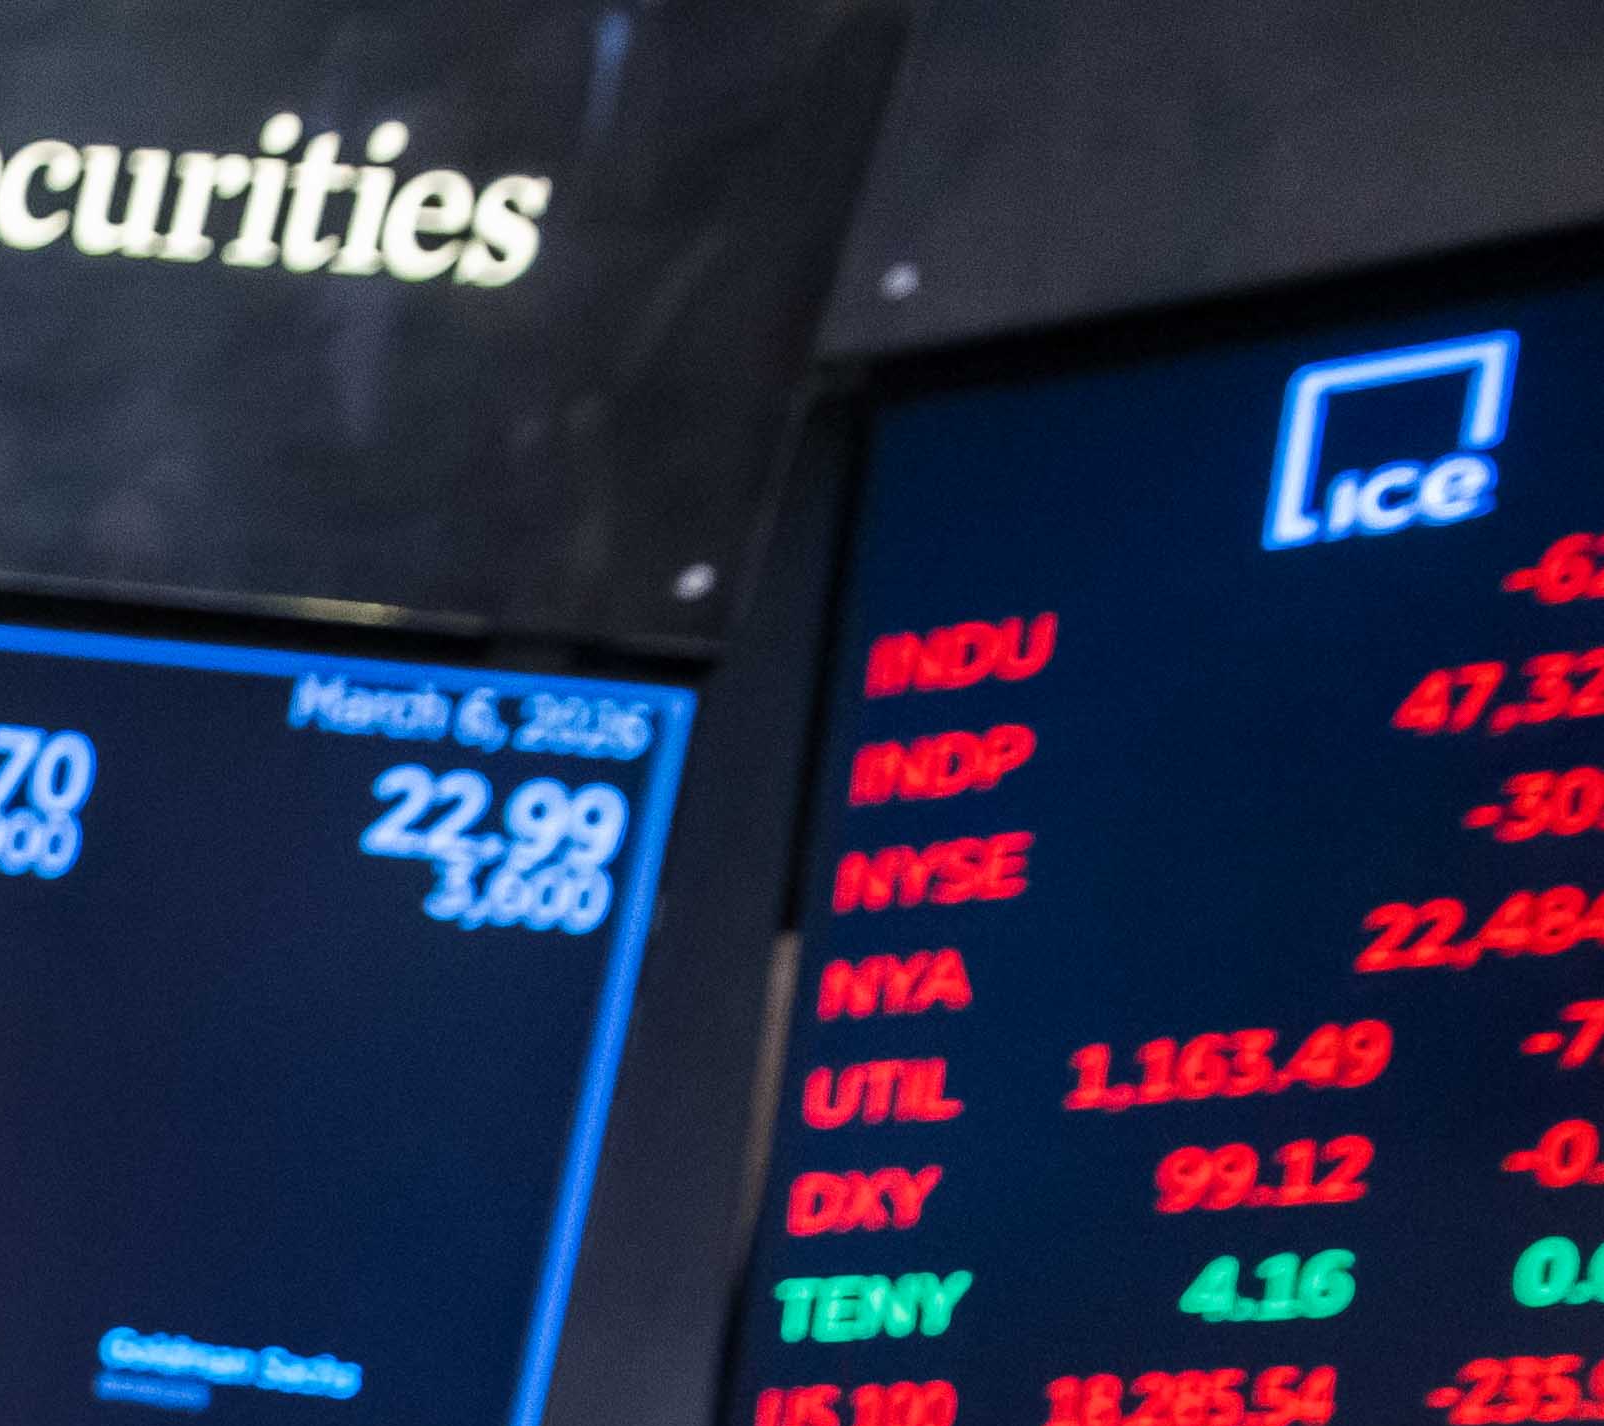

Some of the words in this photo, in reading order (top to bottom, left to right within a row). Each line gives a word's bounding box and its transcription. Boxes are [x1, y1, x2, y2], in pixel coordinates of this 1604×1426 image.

[865, 611, 1059, 698] INDU
[287, 673, 451, 742] March
[848, 723, 1038, 806] INDP
[358, 762, 630, 870] 22.99
[832, 830, 1036, 914] NYSE
[816, 945, 973, 1021] NYA
[802, 1057, 965, 1130] UTIL
[1062, 1019, 1395, 1111] 1,163.49
[786, 1164, 943, 1236] DXY
[1155, 1134, 1375, 1213] 99.12
[773, 1268, 974, 1344] TENY
[1179, 1248, 1357, 1321] 4.16
